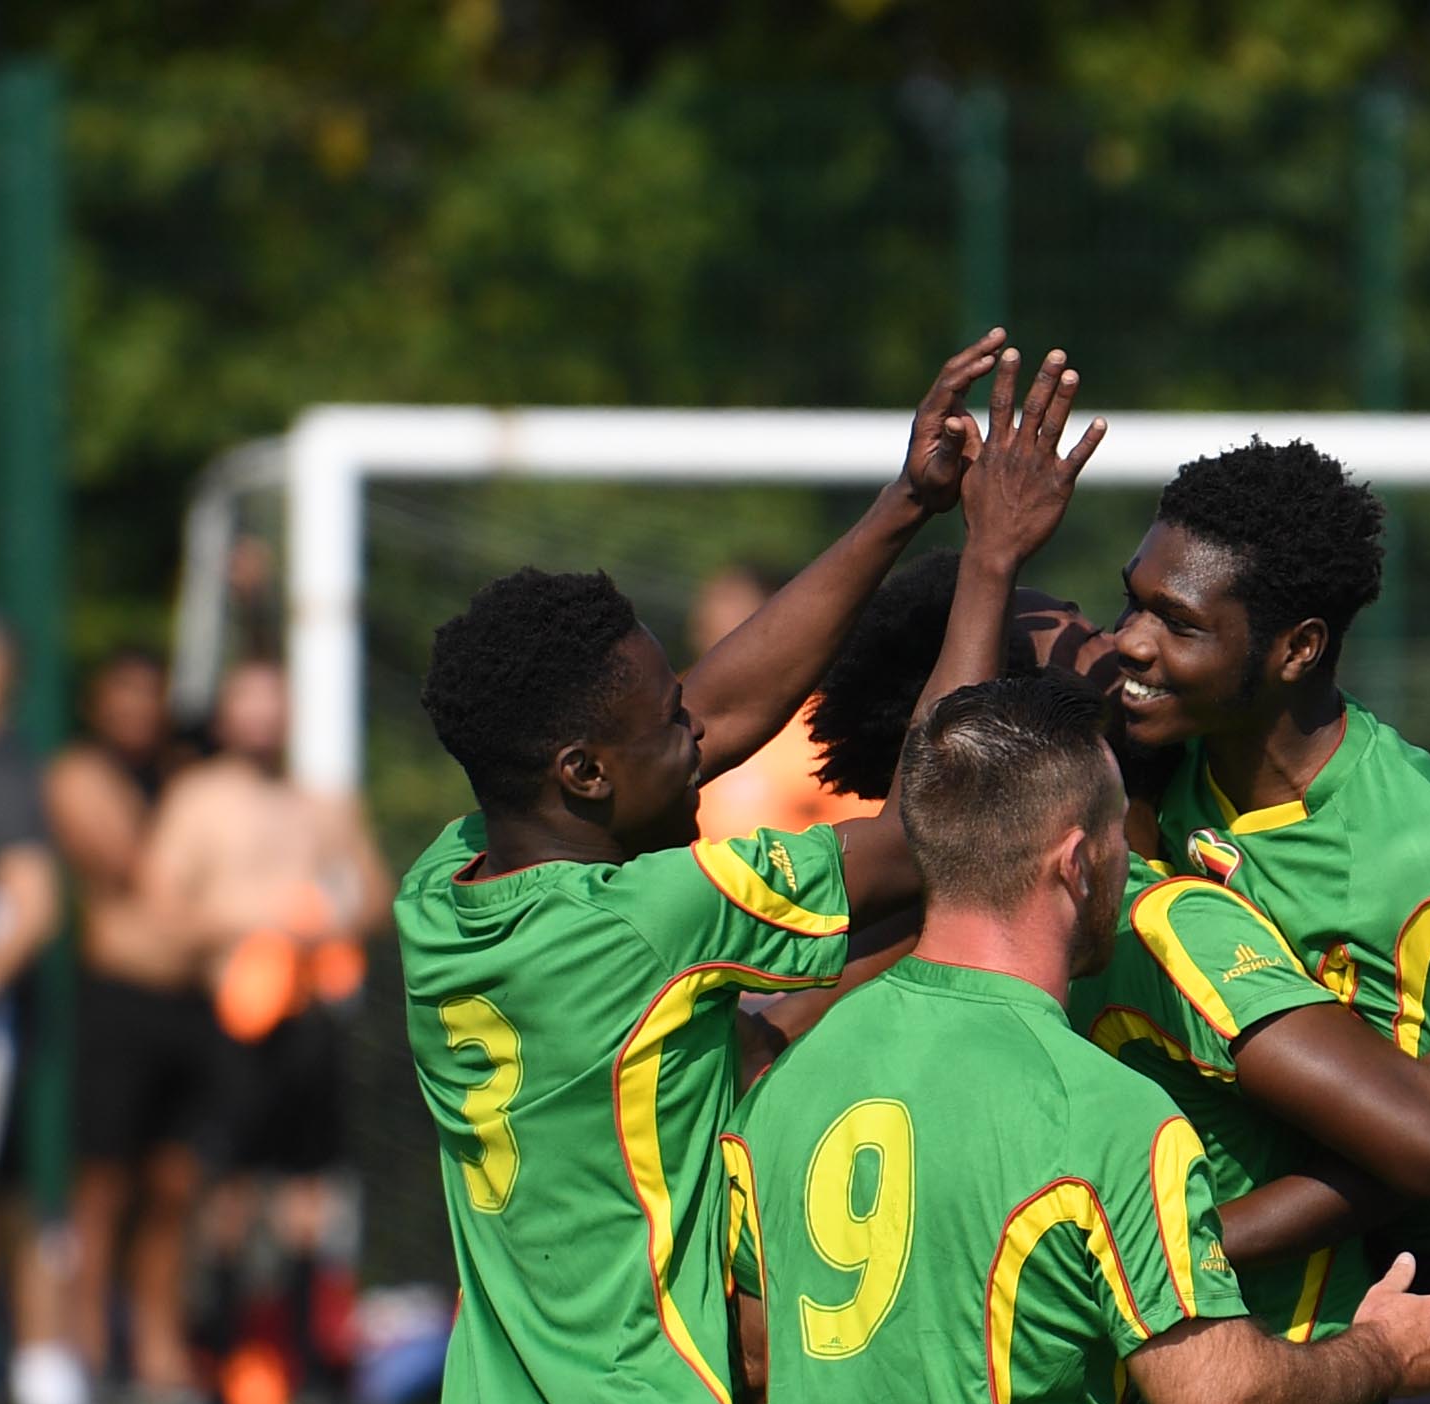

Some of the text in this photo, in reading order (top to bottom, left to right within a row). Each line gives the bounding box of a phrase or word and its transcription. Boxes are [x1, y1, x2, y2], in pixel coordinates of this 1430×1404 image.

[1222, 956, 1283, 983] JOSHILA
[438, 994, 523, 1215] 3
[799, 1098, 916, 1361] 9
